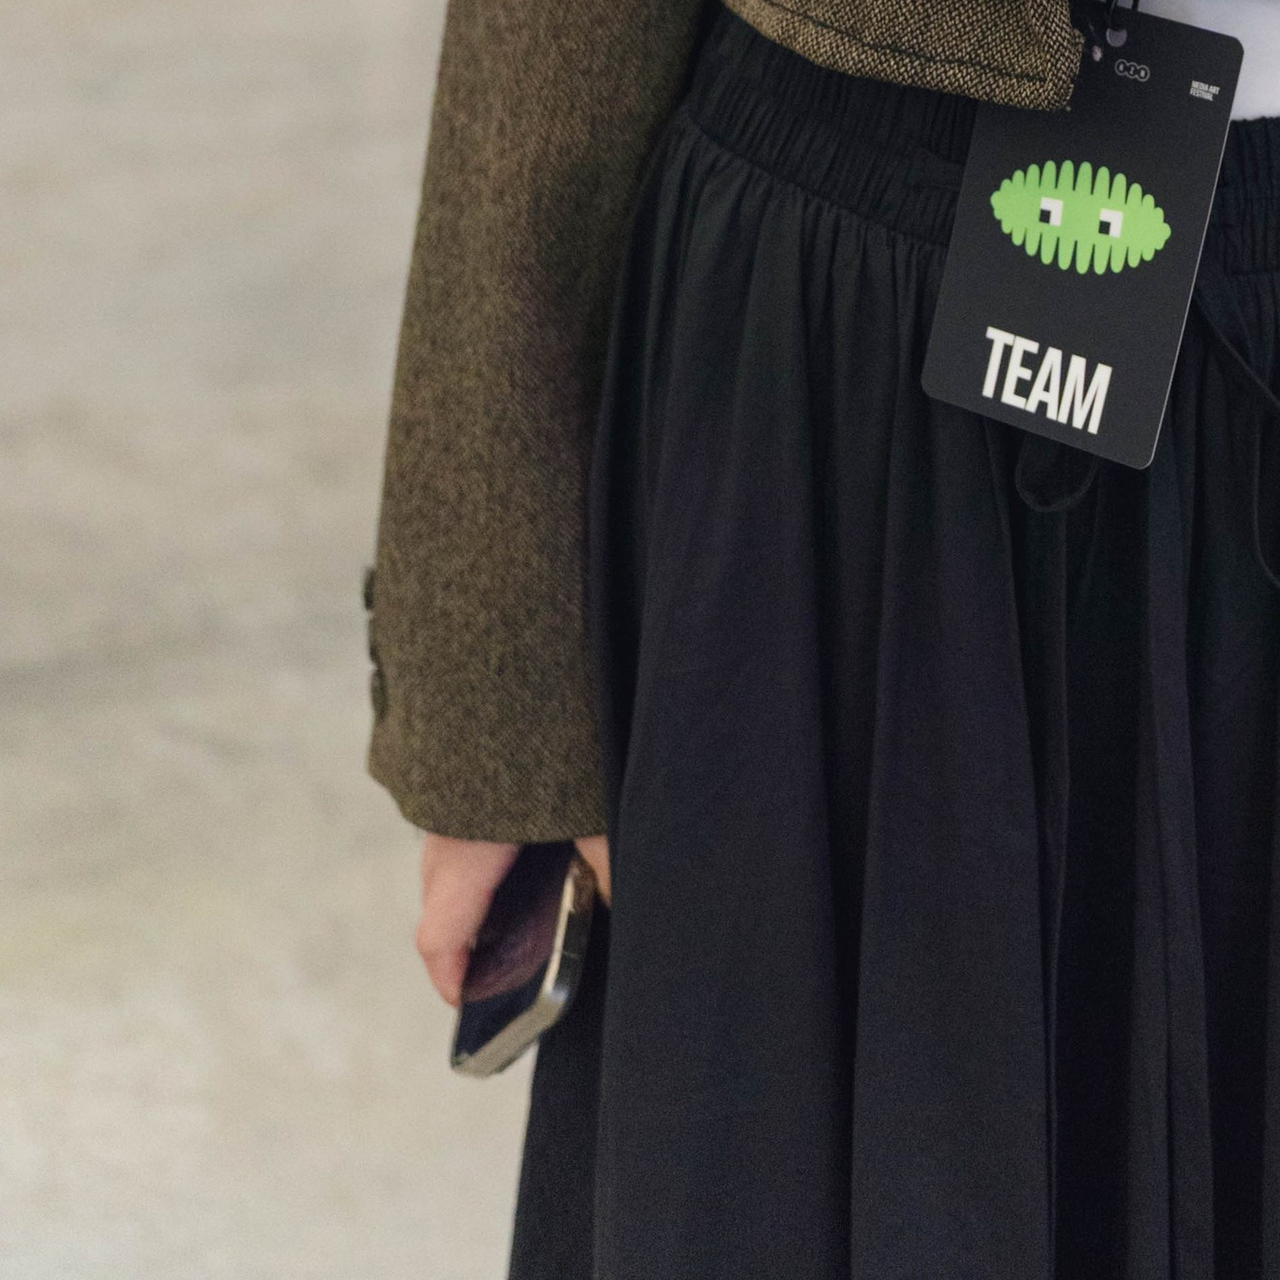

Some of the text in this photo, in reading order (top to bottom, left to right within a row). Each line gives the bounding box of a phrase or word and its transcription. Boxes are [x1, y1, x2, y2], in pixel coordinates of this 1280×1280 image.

[1190, 87, 1214, 101] FESTIVAL
[1209, 85, 1220, 95] ART
[982, 326, 1113, 435] TEAM
